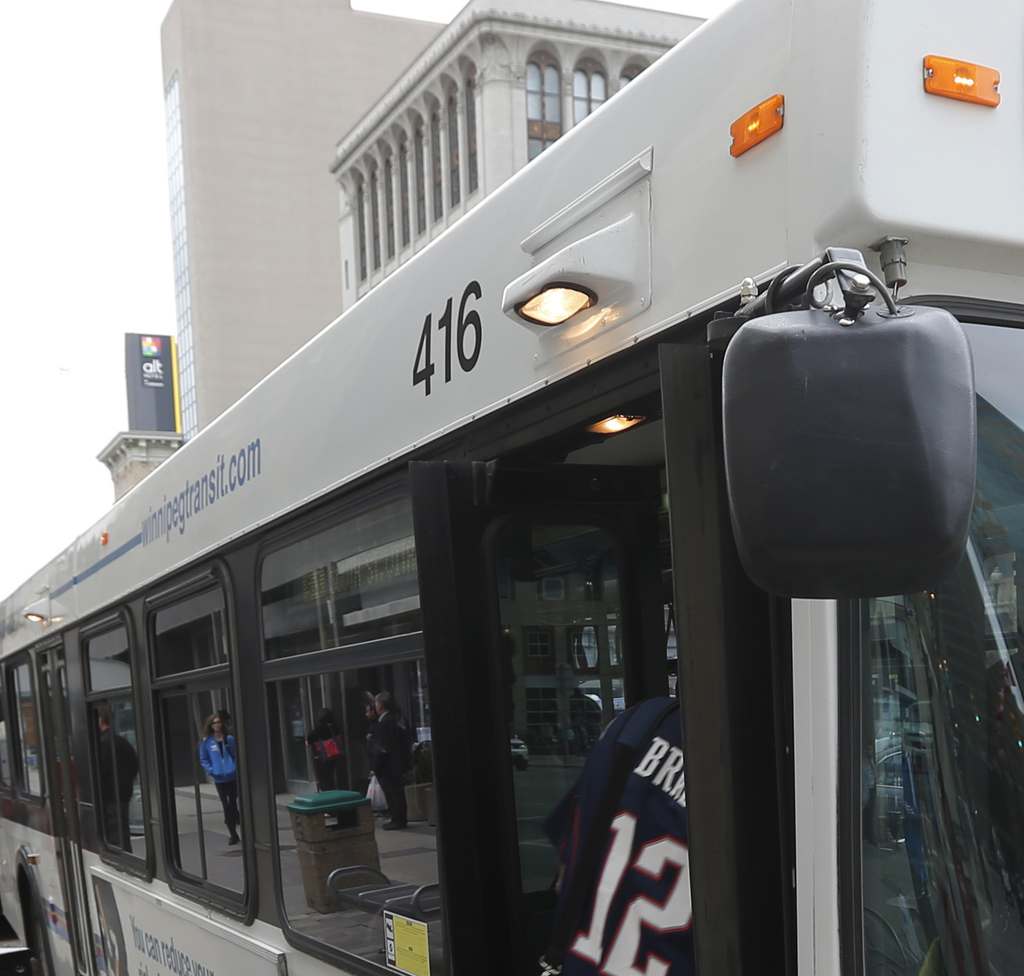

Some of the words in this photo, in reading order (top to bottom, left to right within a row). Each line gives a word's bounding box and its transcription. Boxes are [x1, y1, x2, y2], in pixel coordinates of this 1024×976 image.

[412, 279, 483, 397] 416
[141, 437, 262, 548] winnipegtransit.com
[129, 914, 146, 954] You
[145, 931, 162, 966] can
